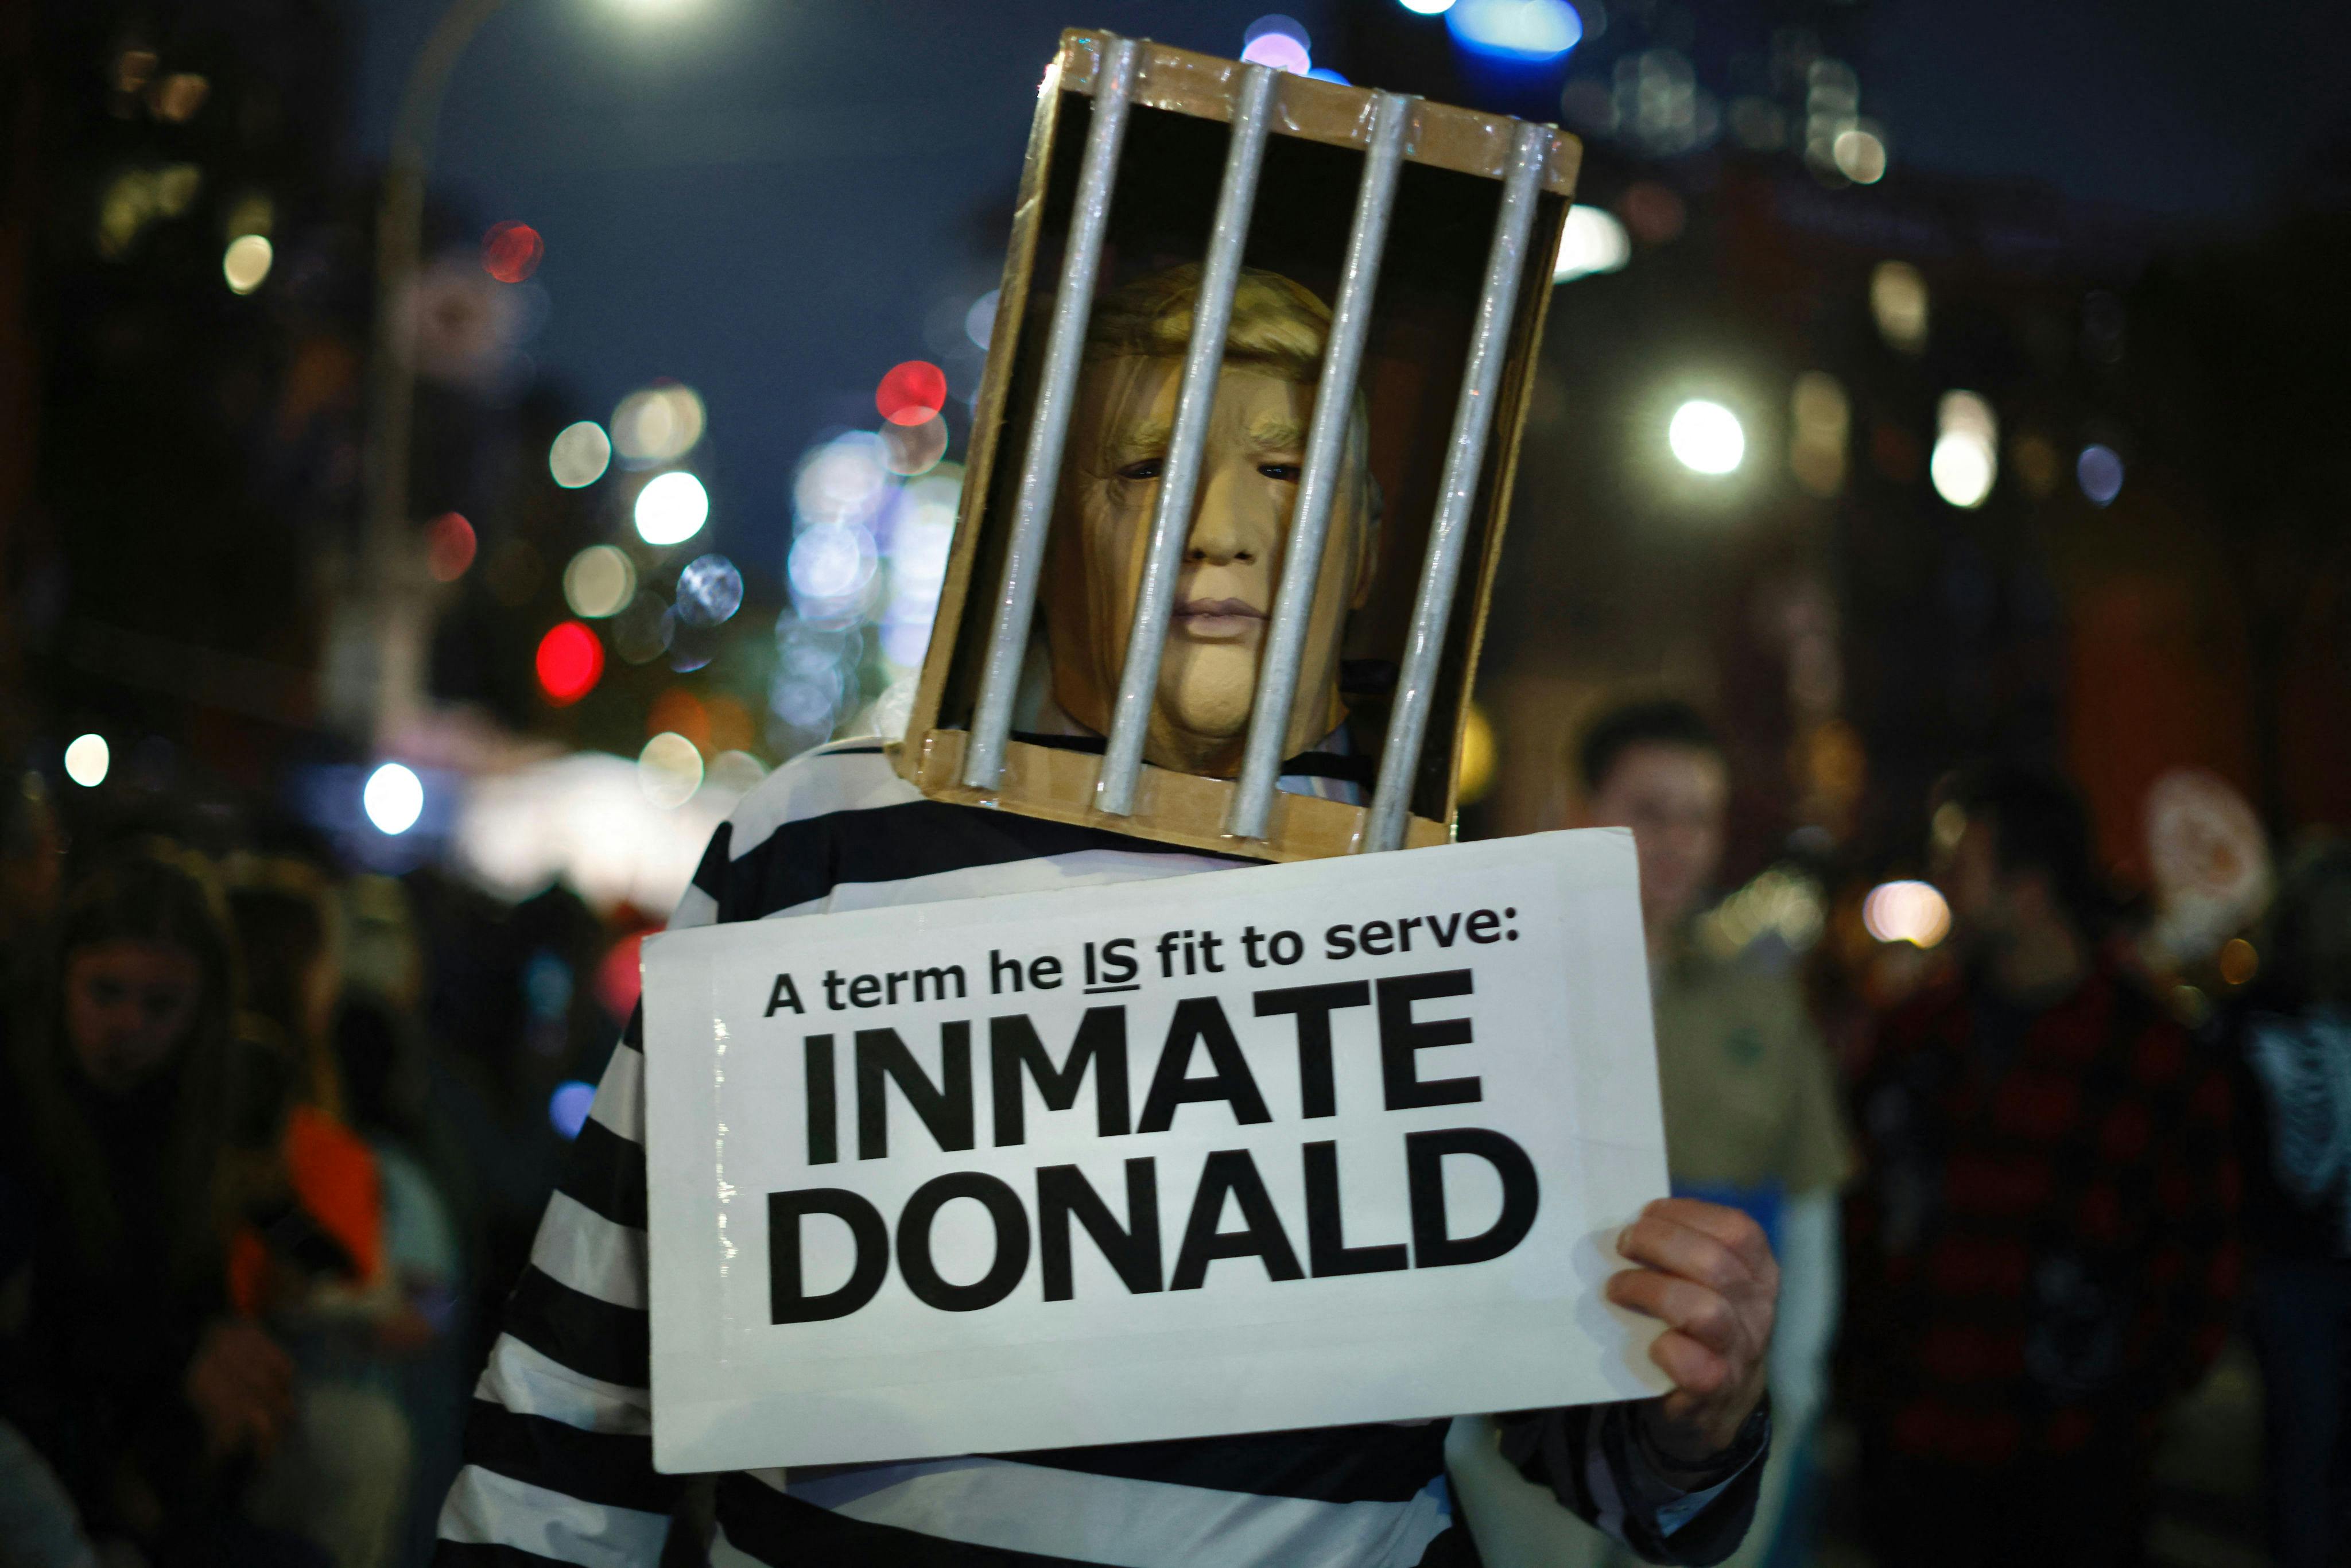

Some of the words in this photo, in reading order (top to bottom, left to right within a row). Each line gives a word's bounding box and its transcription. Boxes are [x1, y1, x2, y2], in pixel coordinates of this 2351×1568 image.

[765, 973, 805, 1018] A
[823, 965, 966, 1011] term
[991, 949, 1062, 995] he
[1084, 938, 1139, 986] IS
[1157, 930, 1224, 978] fit
[1242, 926, 1303, 968] to
[1326, 907, 1519, 960] serve:
[805, 968, 1483, 1166] INMATE
[767, 1127, 1539, 1325] DONALD
